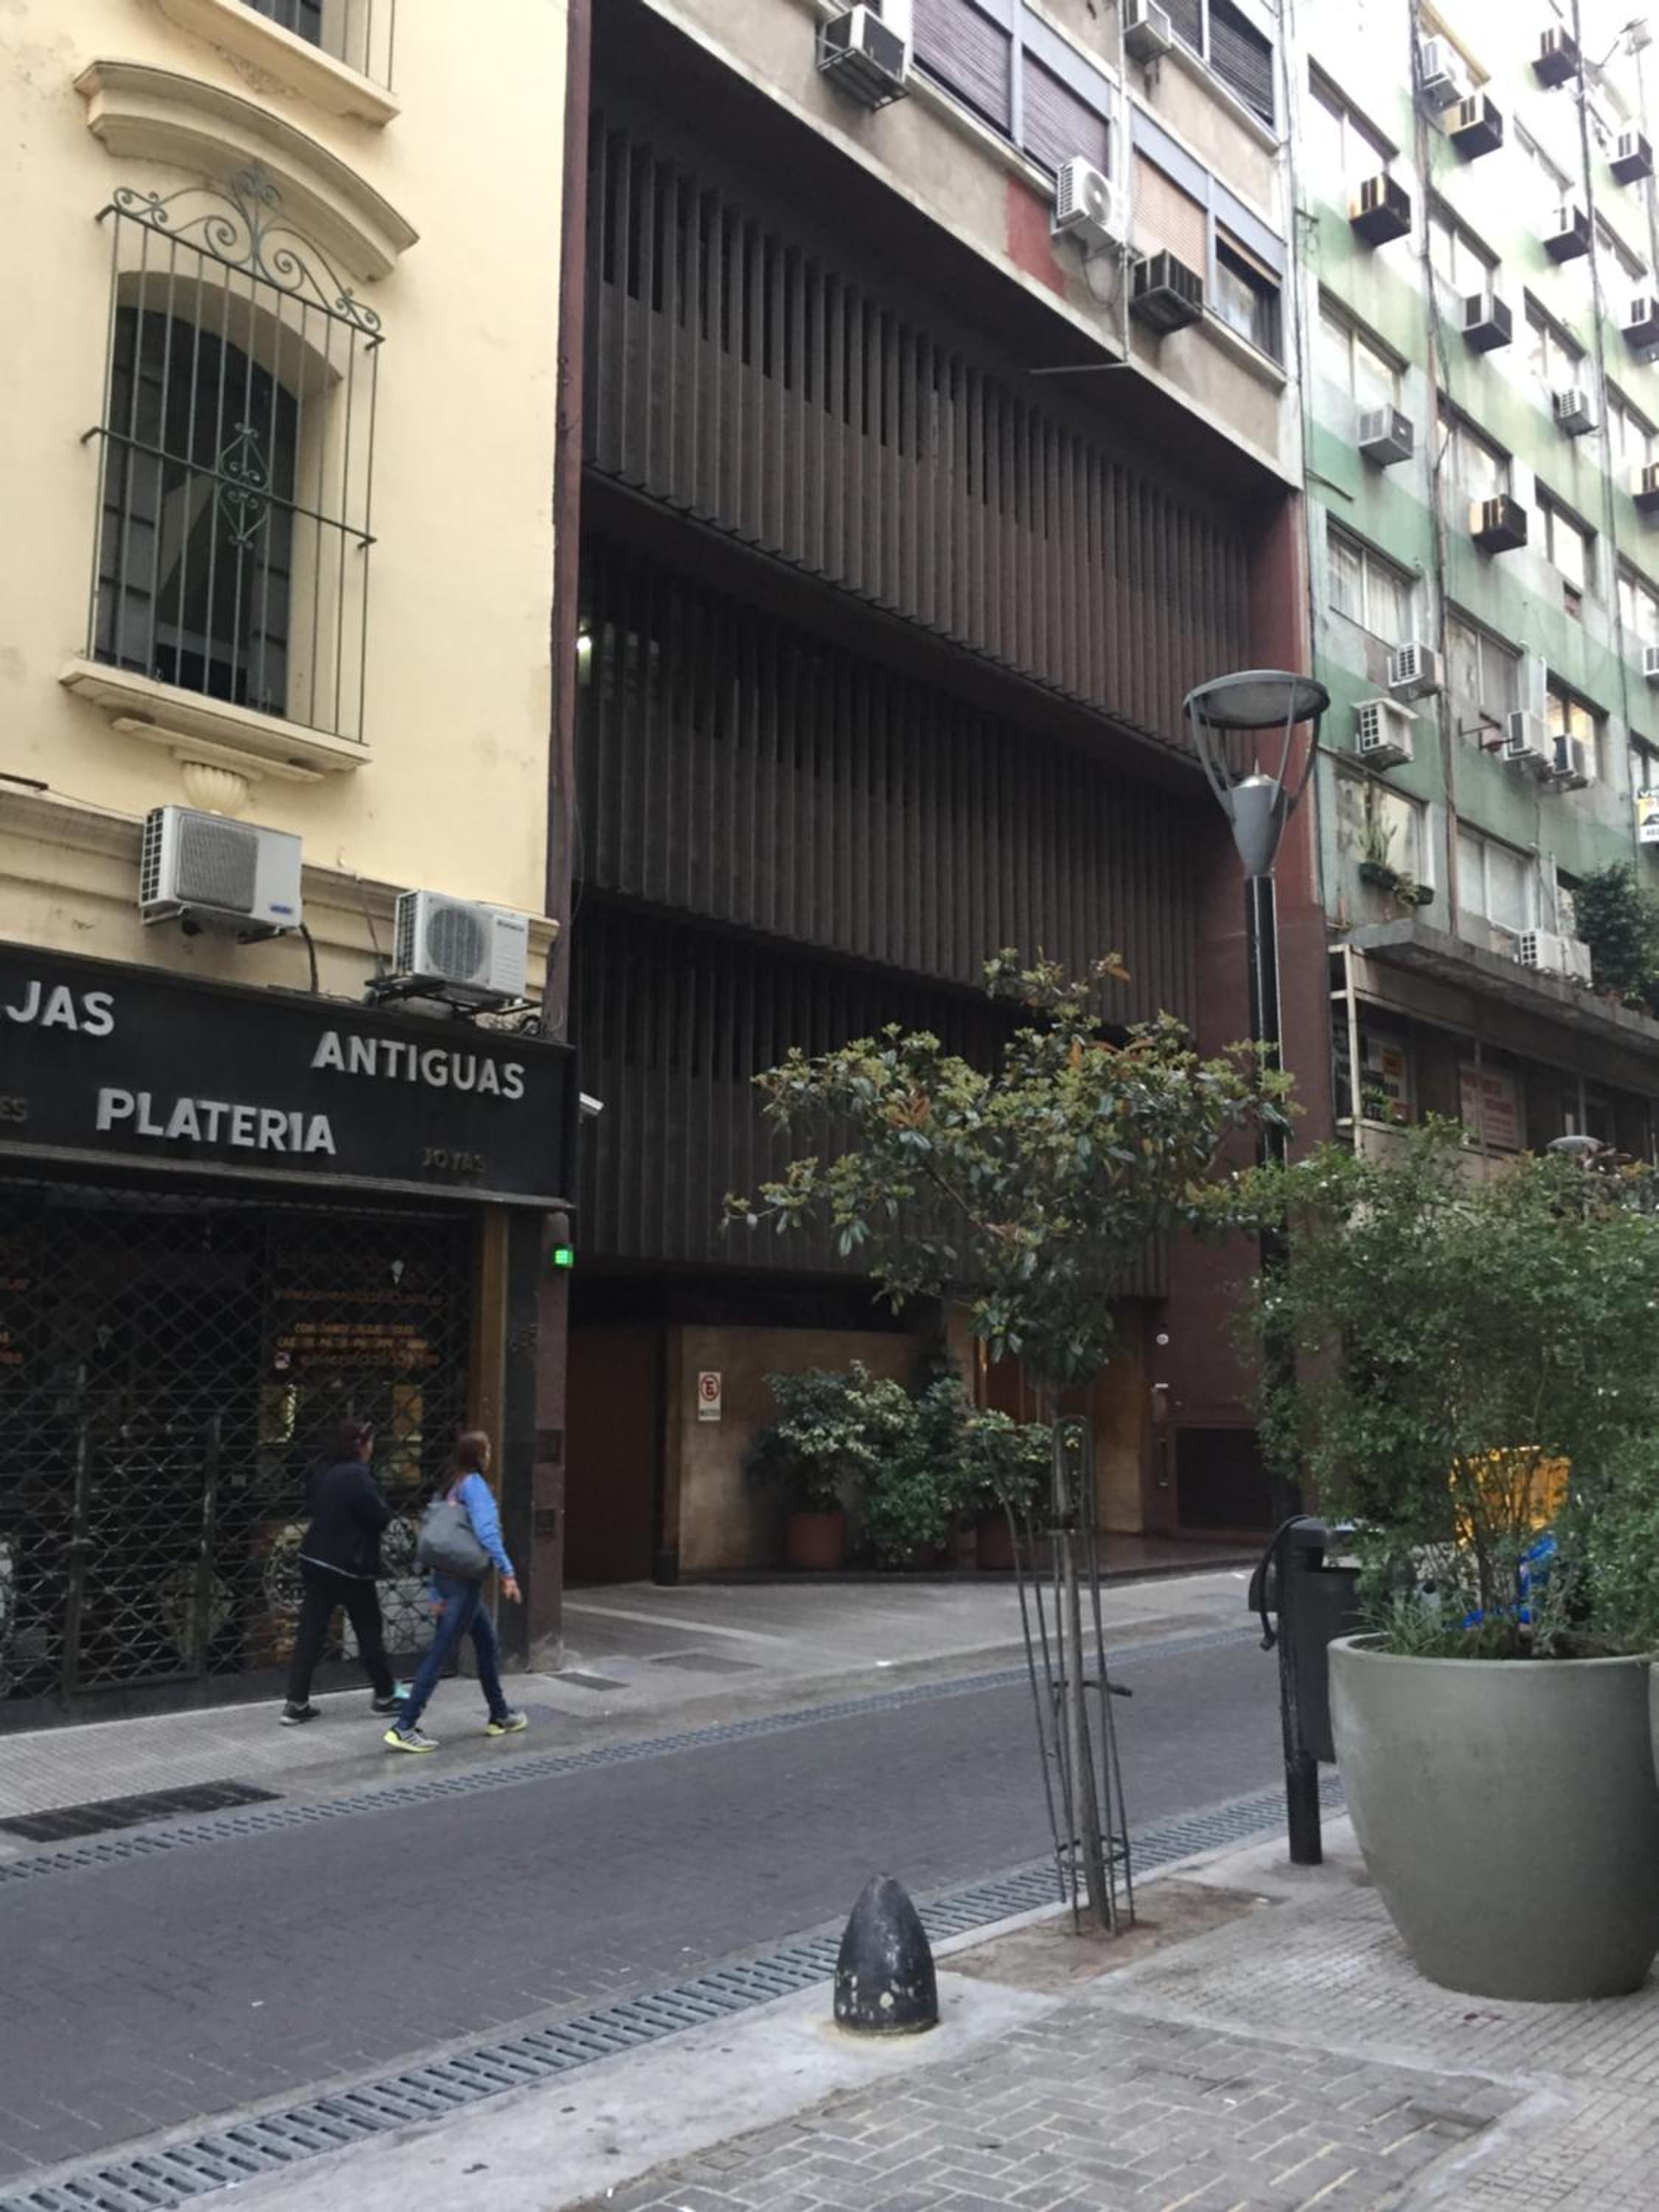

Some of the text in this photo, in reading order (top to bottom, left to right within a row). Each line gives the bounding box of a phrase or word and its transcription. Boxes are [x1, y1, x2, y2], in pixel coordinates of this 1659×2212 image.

[6, 981, 526, 1099] JAS ANTIGUAS
[95, 1088, 337, 1155] PLATERIA
